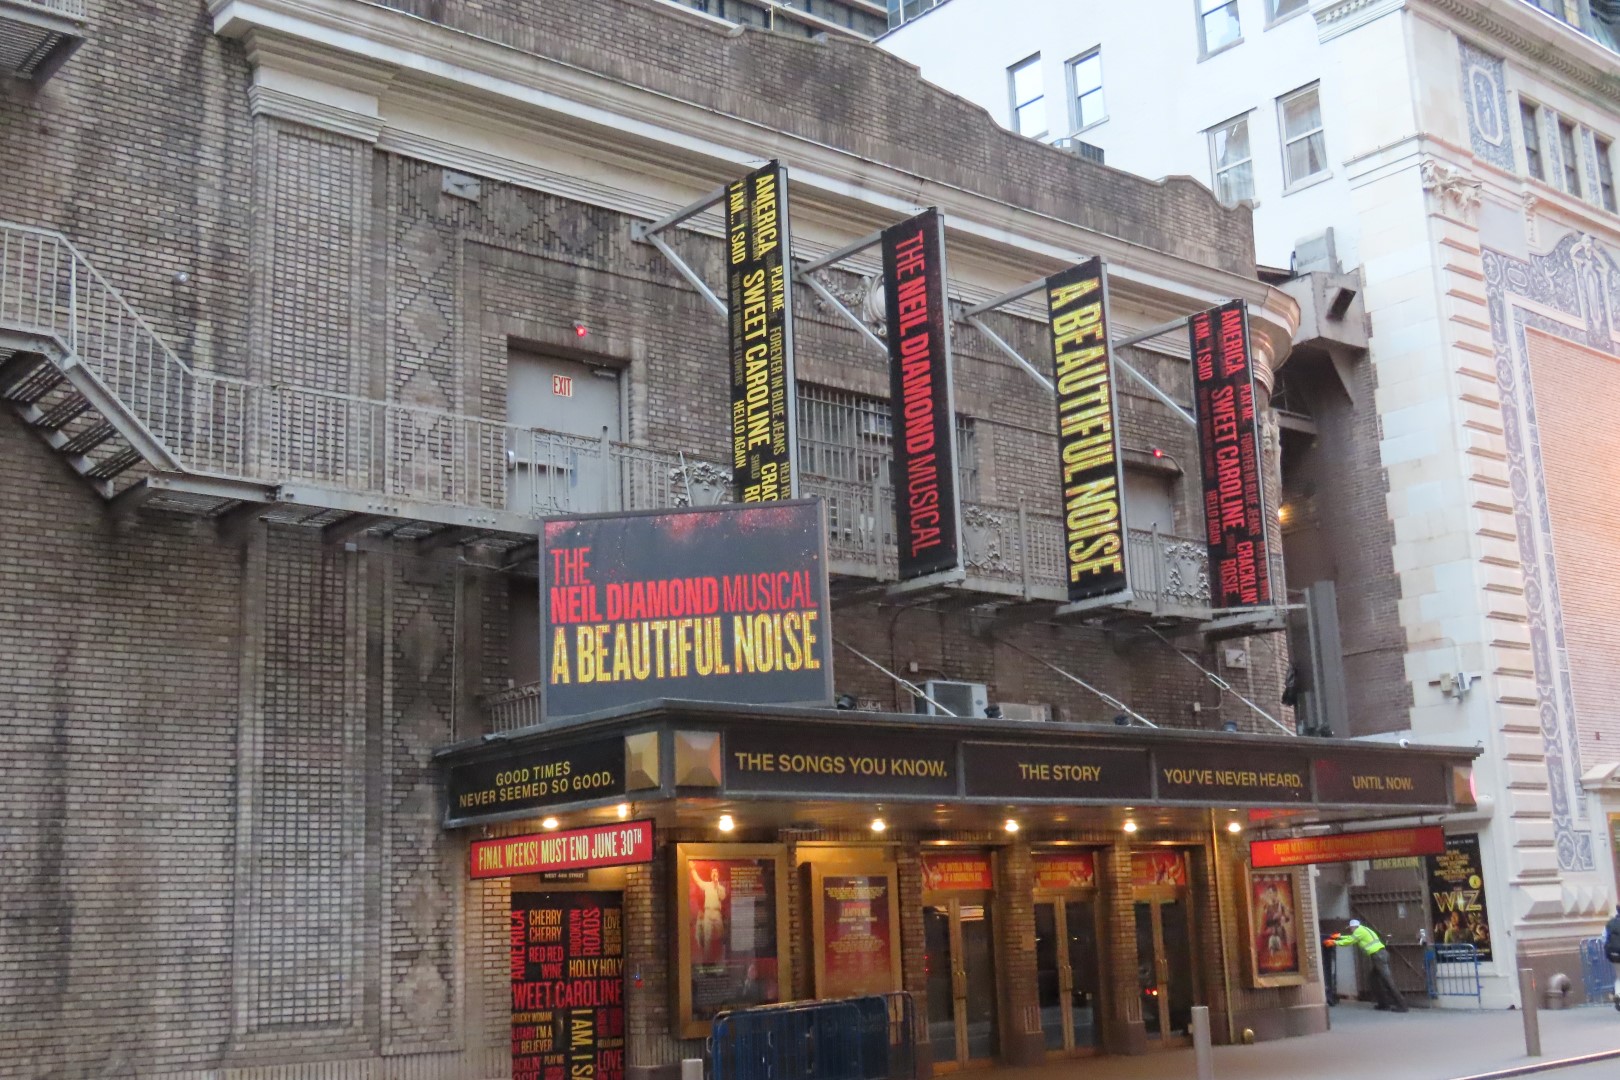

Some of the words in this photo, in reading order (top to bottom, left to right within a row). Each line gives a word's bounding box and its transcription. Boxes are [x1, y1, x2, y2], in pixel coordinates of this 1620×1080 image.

[756, 174, 777, 256] AMERICA
[732, 231, 746, 264] SAID
[895, 229, 925, 281] THE
[771, 265, 783, 292] PLAY
[1051, 276, 1100, 311] A
[743, 269, 767, 341] SWEET
[773, 293, 785, 312] ME
[897, 276, 929, 338] NEIL
[770, 326, 783, 374] FOREVER
[1221, 309, 1245, 376] AMERICA
[771, 375, 784, 390] IN
[1198, 353, 1213, 381] SAID
[553, 375, 572, 396] EXIT
[745, 343, 771, 451] CAROLINE
[900, 332, 935, 454] DIAMOND
[1053, 302, 1114, 483] BEAUTIFUL
[734, 400, 745, 435] HELLO
[771, 389, 785, 418] BLUE
[1211, 385, 1238, 443] SWEET
[735, 436, 746, 469] AGAIN
[773, 420, 786, 456] JEANS
[908, 453, 941, 557] MUSICAL
[1217, 445, 1245, 532] CAROLINE
[1065, 477, 1124, 583] NOISE
[550, 547, 591, 586] THE
[1221, 558, 1239, 597] ROSIE
[551, 585, 603, 624] NEIL
[606, 577, 719, 621] DIAMOND
[723, 570, 818, 613] MUSICAL
[551, 626, 570, 685] A
[576, 615, 730, 684] BEAUTIFUL
[734, 611, 820, 673] NOISE
[496, 769, 529, 787] GOOD
[533, 761, 571, 781] TIMES
[735, 752, 774, 771] THE
[779, 755, 845, 773] SONGS
[848, 757, 886, 775] YOU
[891, 759, 948, 778] KNOW.
[1018, 763, 1050, 781] THE
[1053, 765, 1101, 782] STORY
[1164, 768, 1214, 785] YOU'VE
[1216, 771, 1257, 786] NEVER
[1259, 773, 1303, 788] HEARD.
[459, 789, 496, 808] NEVER
[499, 782, 547, 802] SEEMED
[552, 779, 568, 794] SO
[573, 772, 615, 789] GOOD.
[1352, 776, 1384, 790] UNTIL
[1386, 778, 1413, 791] NOW.
[478, 846, 503, 871] FINAL
[505, 842, 539, 868] WEEKS!
[541, 838, 567, 865] MUST
[570, 835, 589, 861] END
[592, 832, 618, 859] JUNE
[620, 828, 642, 856] 30TH
[529, 909, 562, 926] CHERRY
[1433, 890, 1482, 913] WIZ
[511, 909, 526, 980] AMERICA
[529, 926, 562, 943] CHERRY
[583, 906, 600, 956] ROADS
[529, 946, 546, 963] RED
[547, 946, 564, 962] RED
[541, 963, 563, 979] WINE
[569, 959, 598, 977] HOLLY
[600, 958, 624, 977] HOLY
[554, 979, 623, 1009] CAROLINE
[521, 1039, 553, 1054] BELIEVER
[547, 1024, 553, 1039] A
[570, 1020, 593, 1051] AM,
[571, 1064, 594, 1080] S
[597, 1050, 623, 1071] LOVE
